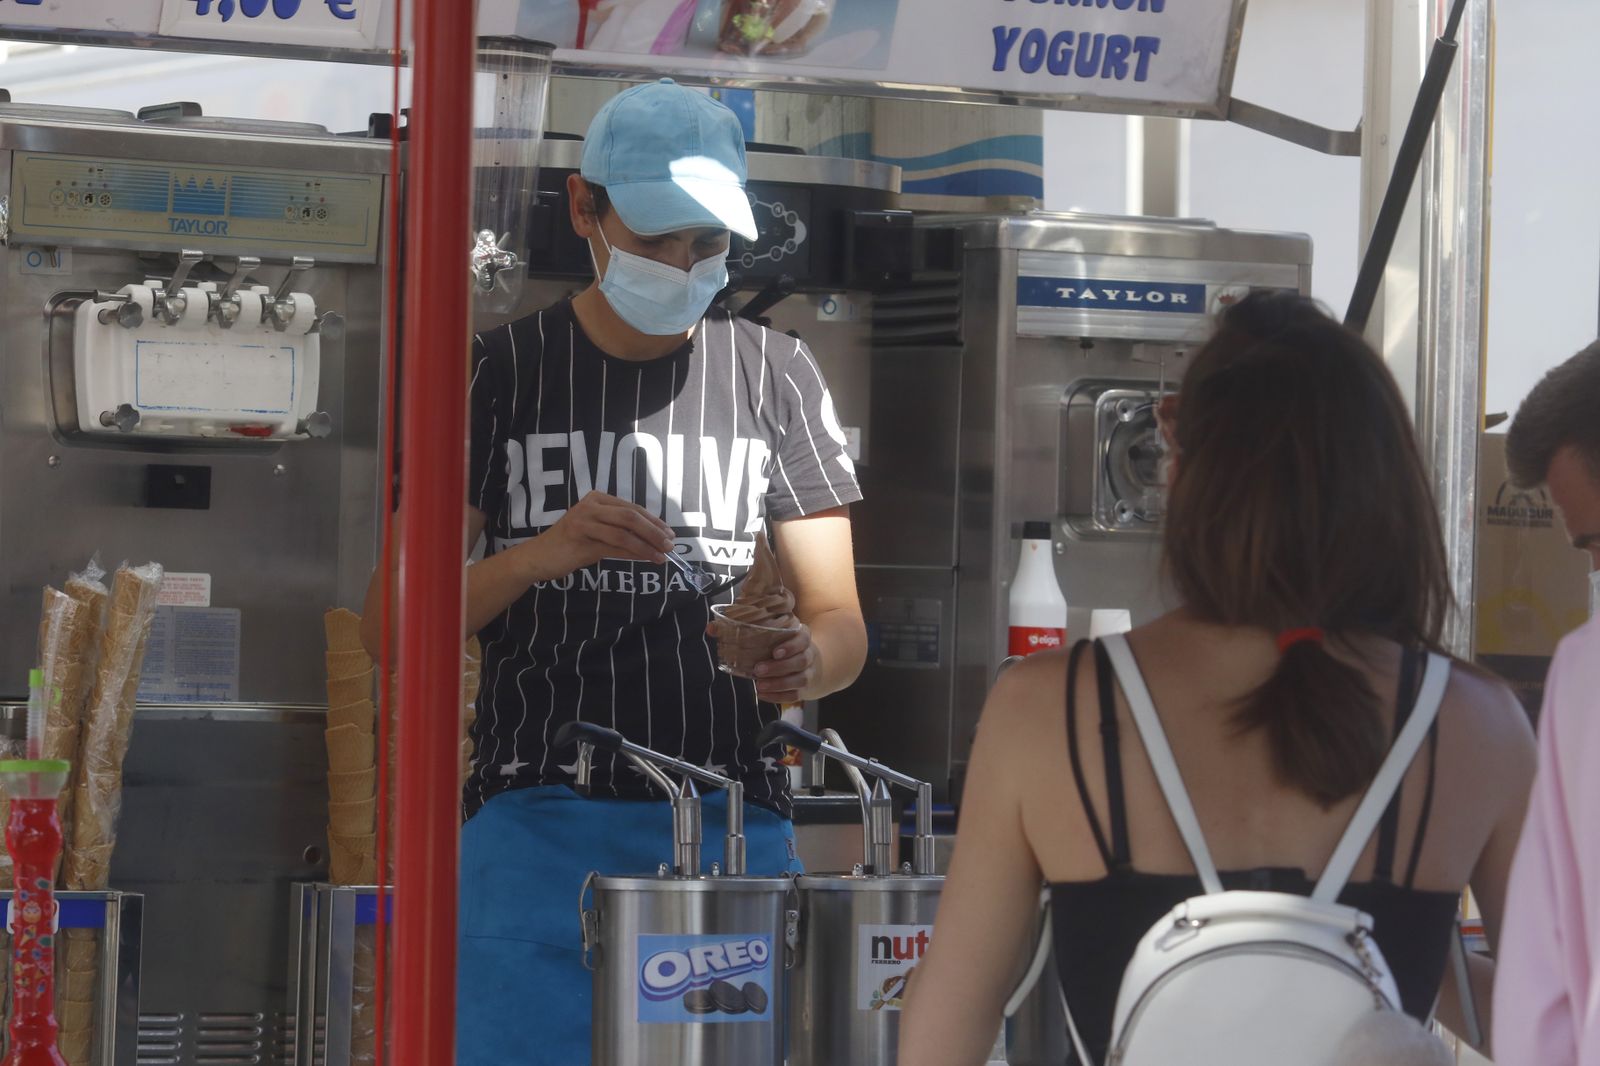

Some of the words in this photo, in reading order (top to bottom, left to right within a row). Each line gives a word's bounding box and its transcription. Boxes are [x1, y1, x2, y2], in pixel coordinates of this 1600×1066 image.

[992, 25, 1161, 82] YOGURT
[168, 217, 228, 236] TAYLOR
[1056, 287, 1189, 305] TAYLOR
[643, 939, 769, 989] OREO
